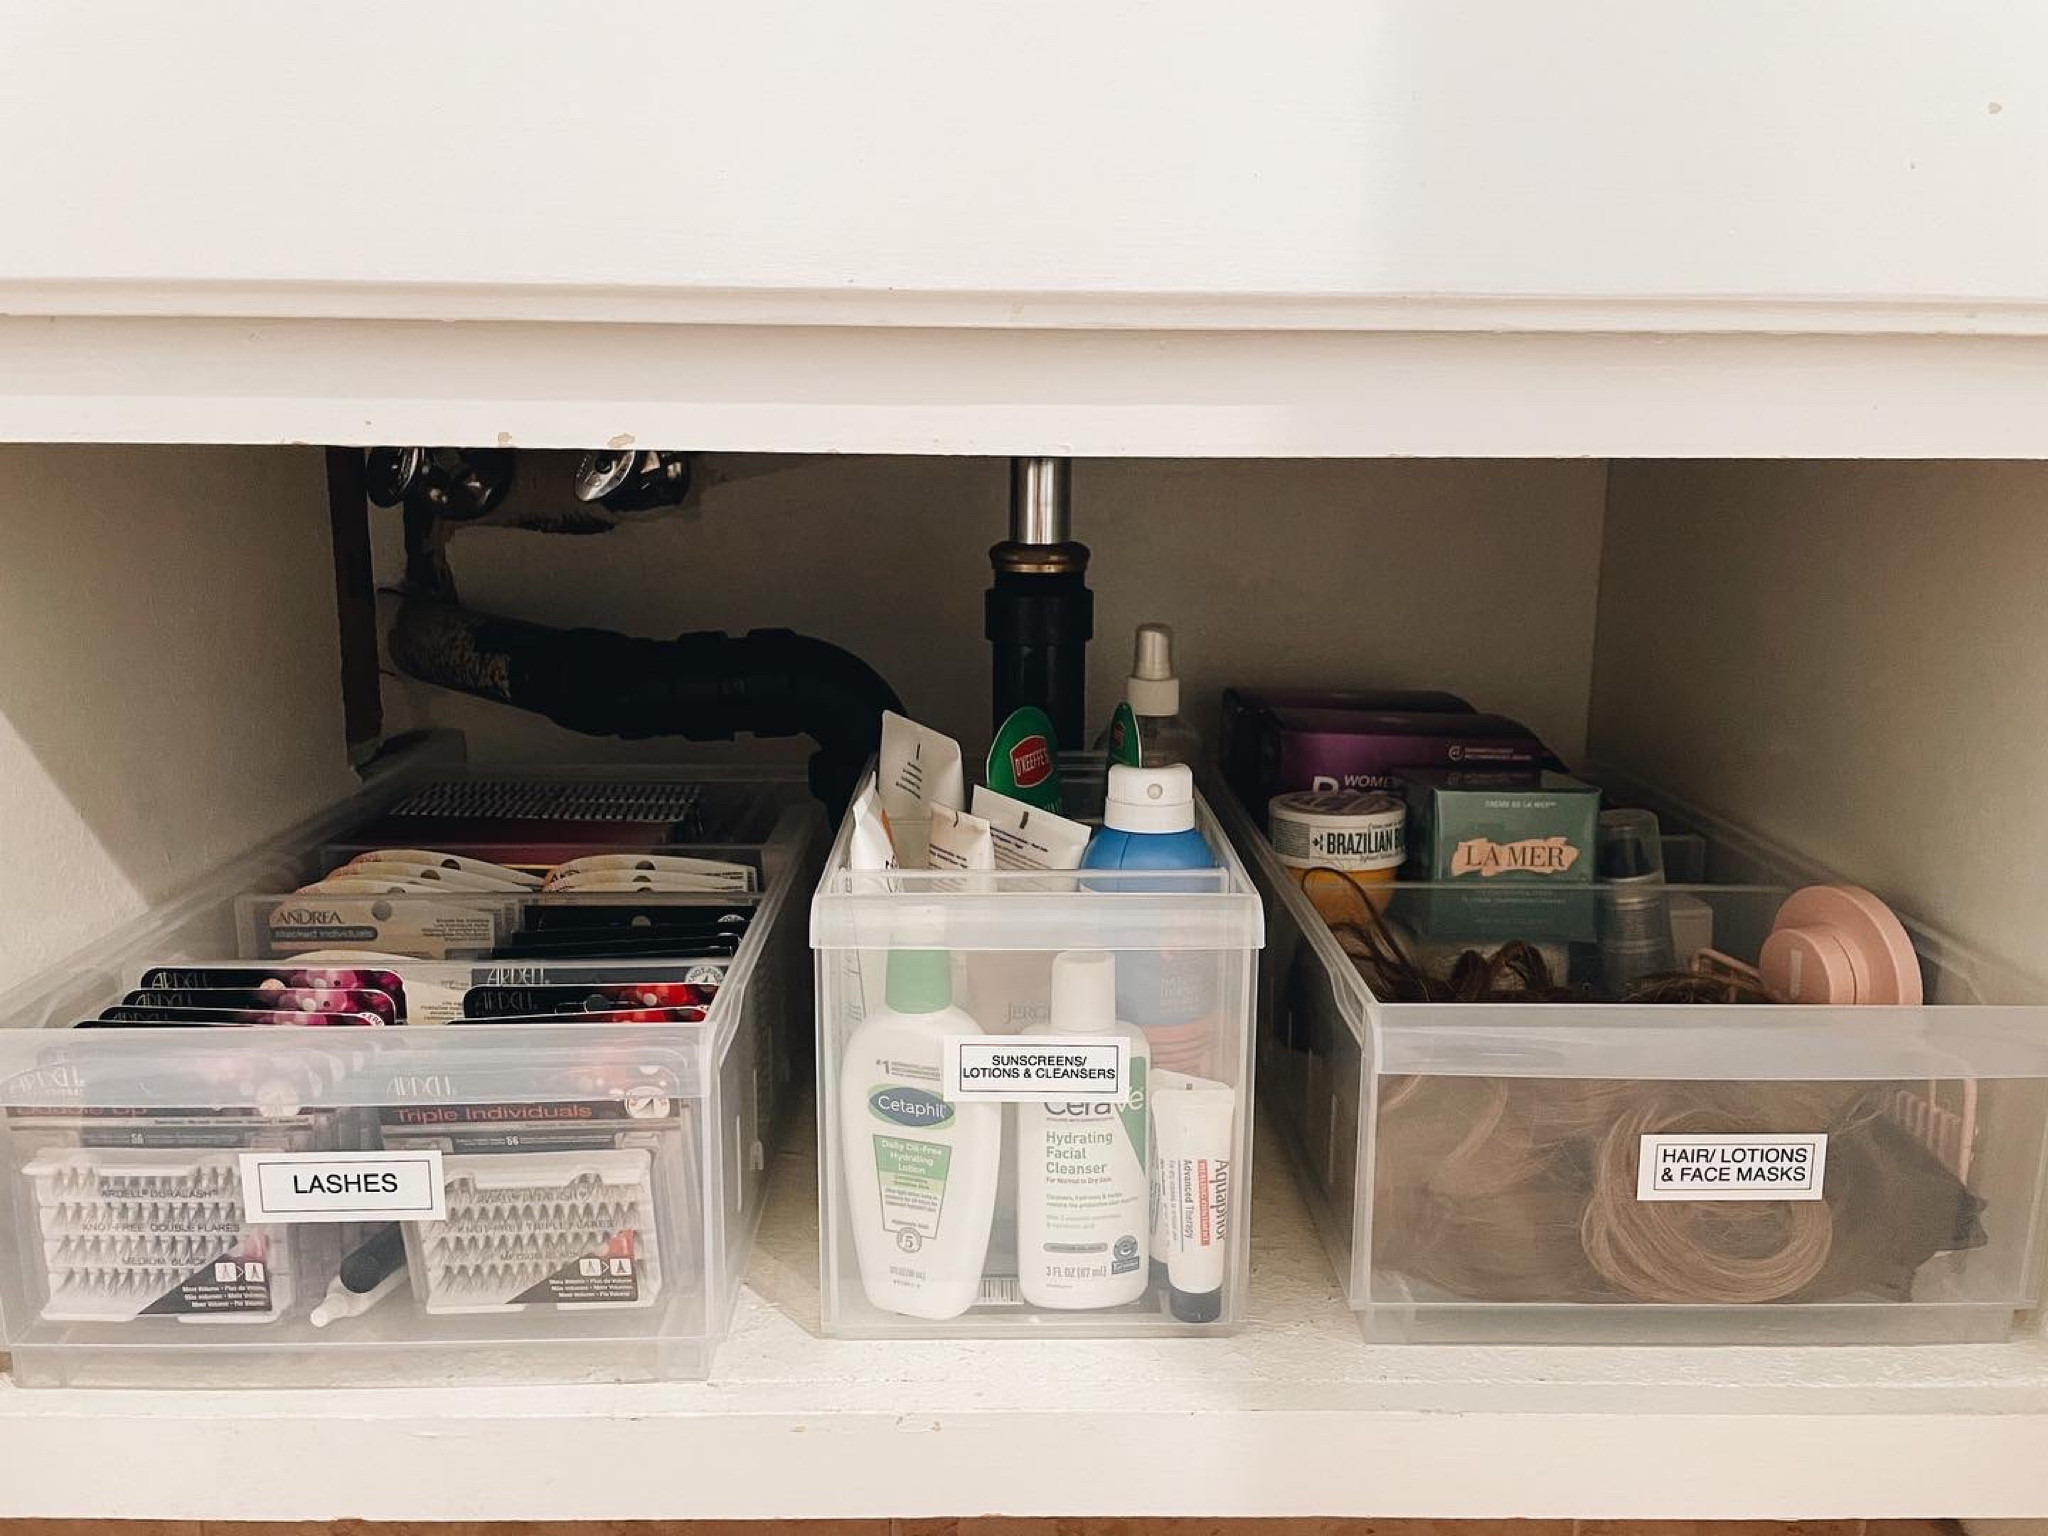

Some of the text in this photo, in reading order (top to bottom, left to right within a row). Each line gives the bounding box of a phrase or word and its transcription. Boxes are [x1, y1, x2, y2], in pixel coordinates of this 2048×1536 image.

[1344, 774, 1394, 788] WOME
[1326, 827, 1393, 856] BRAZILIAN
[1464, 843, 1566, 868] LA MER
[272, 908, 345, 925] ANDREA
[1003, 1004, 1051, 1025] JERG
[992, 1054, 1088, 1067] SUNSCREENS/
[963, 1067, 1117, 1080] LOTIONS & CLEANSERS
[396, 1103, 593, 1126] Triple Individuals
[878, 1095, 946, 1119] Cetaphil
[1046, 1130, 1113, 1146] Hydrating
[1046, 1145, 1087, 1160] Facial
[1662, 1148, 1809, 1164] HAIR/ LOTIONS
[1046, 1161, 1109, 1175] Cleanser
[1660, 1166, 1807, 1183] & FACE MASKS
[293, 1172, 399, 1194] LASHES
[1182, 1159, 1194, 1203] Advanced
[1208, 1159, 1230, 1241] Aquaphor
[1046, 1266, 1051, 1277] 3
